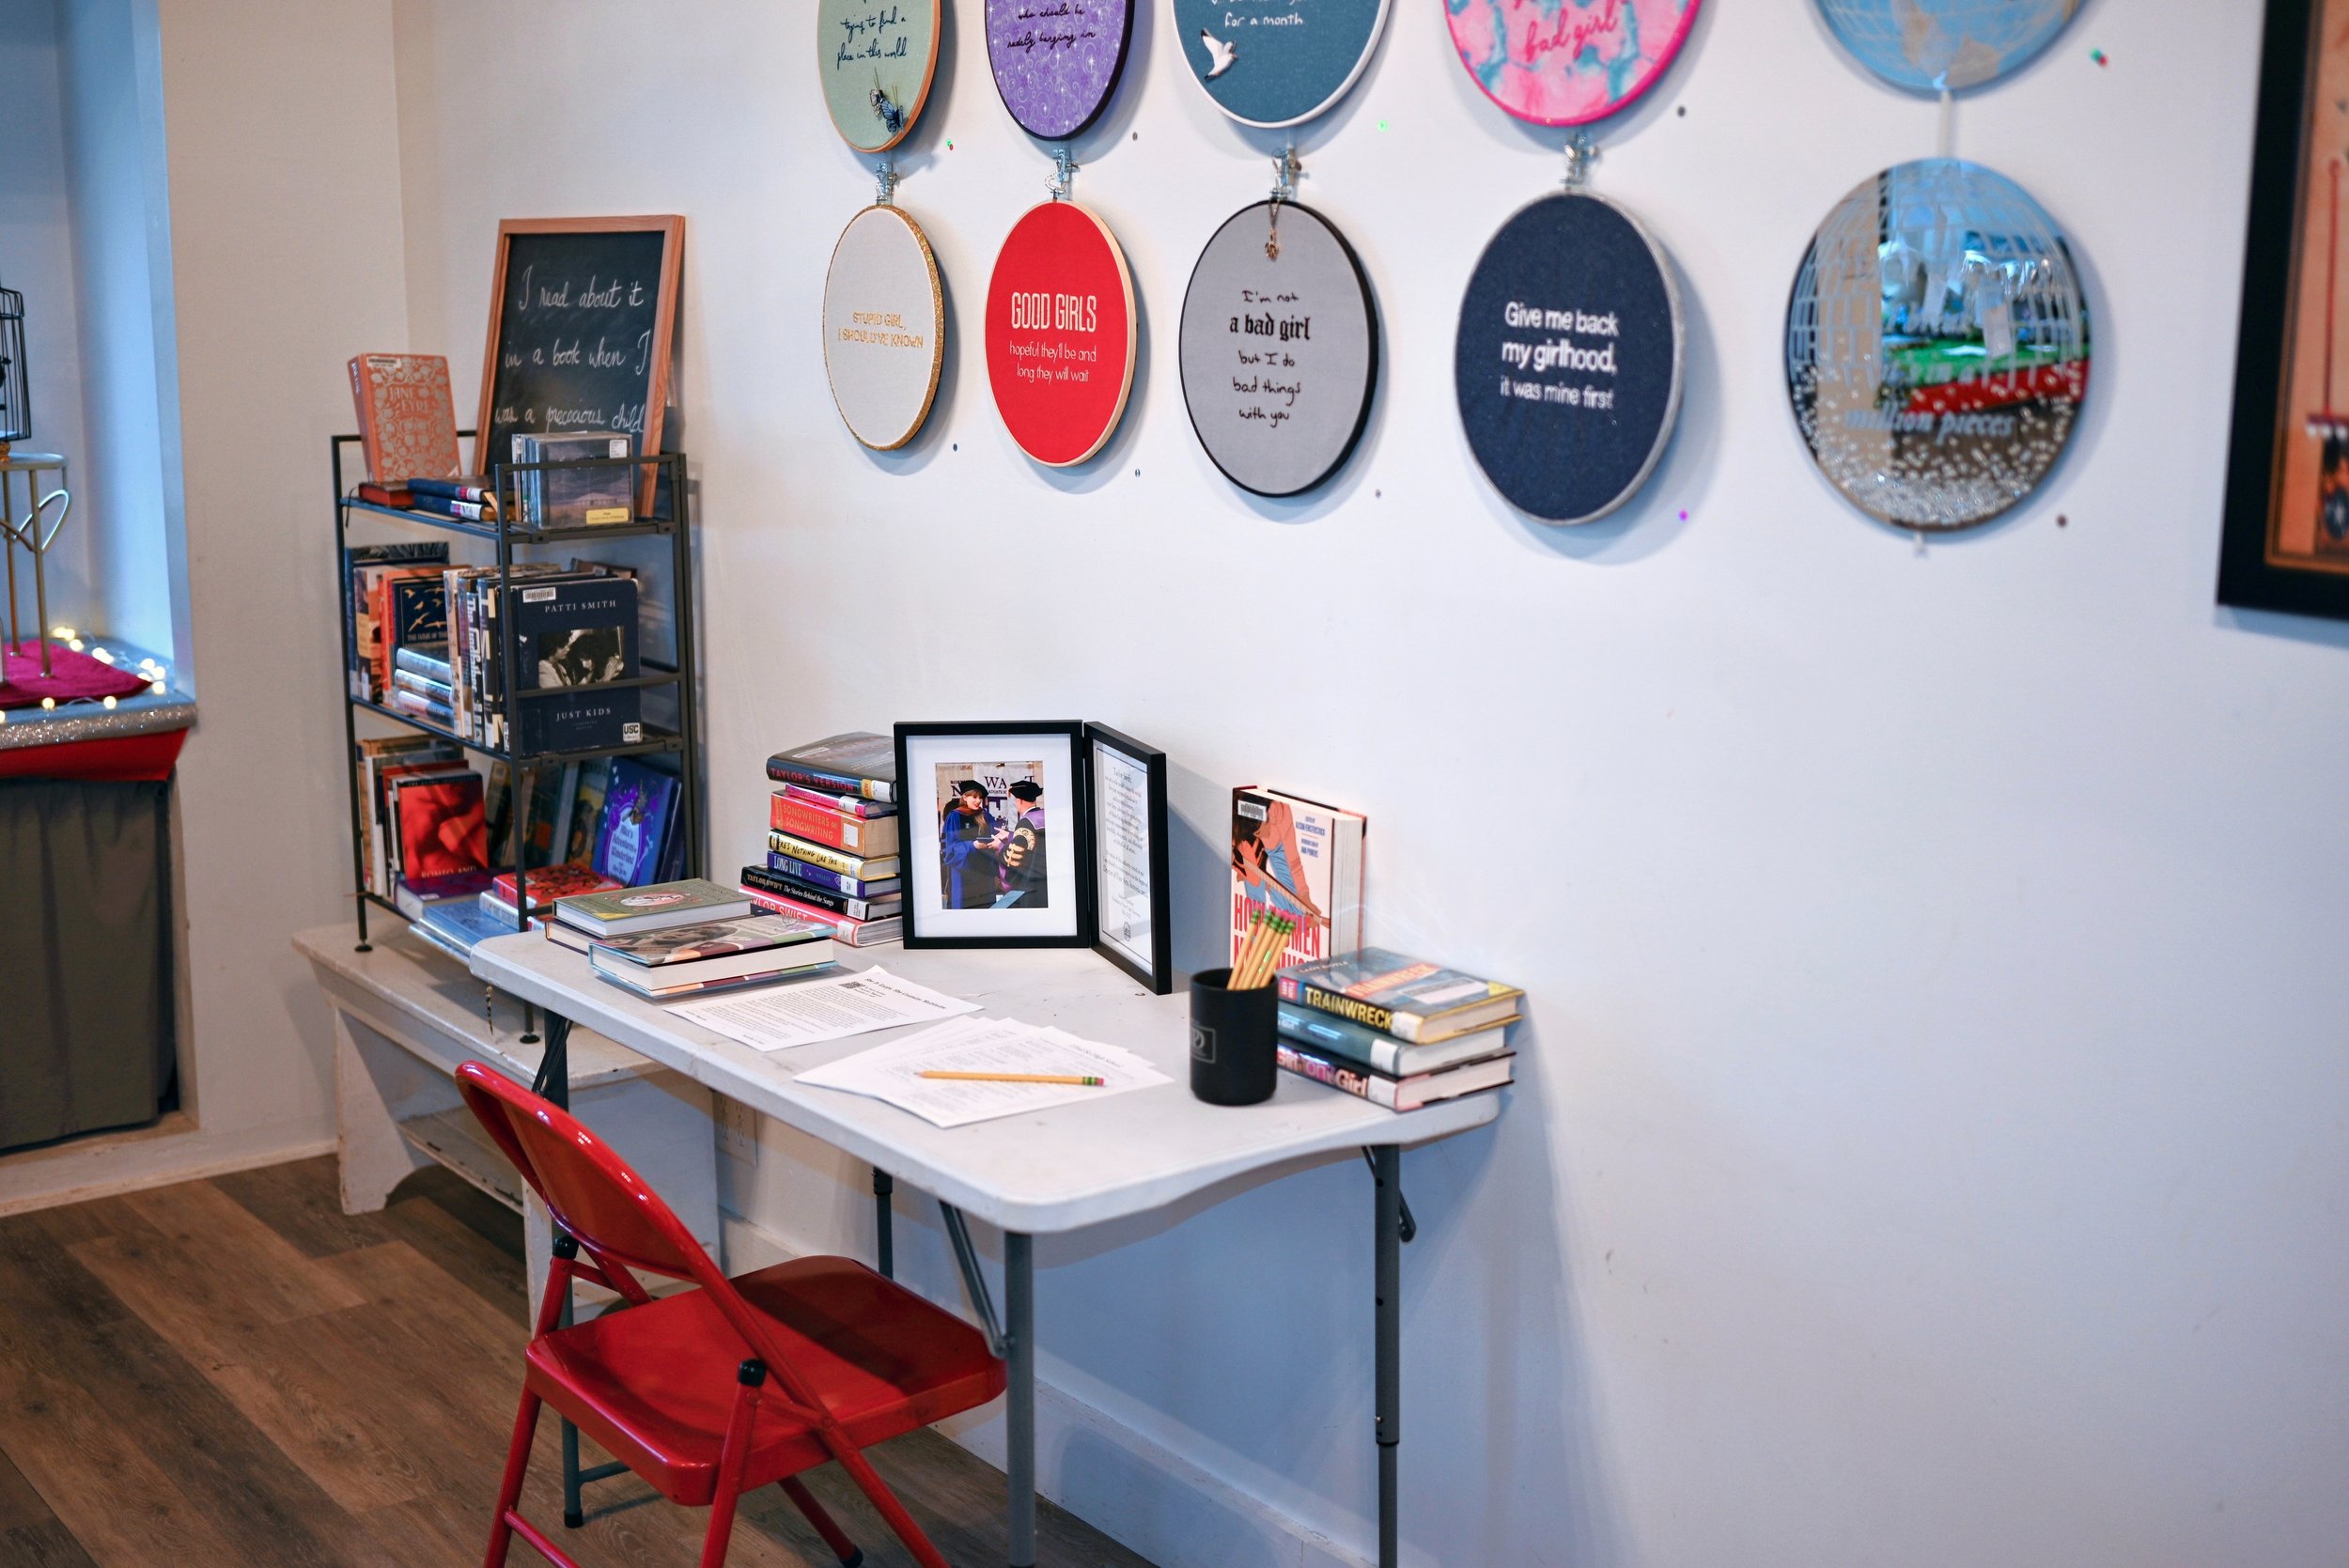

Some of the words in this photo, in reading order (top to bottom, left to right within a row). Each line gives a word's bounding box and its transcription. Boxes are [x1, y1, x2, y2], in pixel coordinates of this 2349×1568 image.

[1074, 4, 1084, 15] be
[1224, 12, 1245, 28] for
[1250, 18, 1258, 26] a
[1263, 12, 1303, 26] month
[840, 15, 865, 43] trying
[865, 15, 876, 27] to
[879, 6, 896, 34] find
[1573, 0, 1618, 59] girl
[837, 42, 854, 70] place
[857, 44, 865, 58] in
[865, 38, 881, 58] this
[884, 37, 907, 58] world
[519, 265, 533, 310] I
[538, 281, 569, 308] read
[579, 274, 622, 308] about
[629, 280, 644, 306] it
[1241, 289, 1271, 303] I'm
[1276, 292, 1299, 302] not
[1011, 291, 1050, 330] GOOD
[1055, 293, 1097, 333] GIRLS
[1504, 301, 1543, 328] Give
[1545, 309, 1574, 331] me
[1575, 308, 1620, 337] back
[1229, 316, 1238, 334] a
[1244, 312, 1274, 336] bad
[1279, 315, 1311, 342] girl
[505, 341, 523, 368] in
[532, 348, 545, 365] a
[552, 338, 580, 366] book
[589, 336, 626, 368] when
[635, 329, 651, 376] I
[890, 333, 924, 348] KNOWN
[1009, 340, 1040, 361] hopeful
[1064, 343, 1077, 359] be
[1078, 345, 1097, 362] and
[1238, 349, 1261, 365] but
[1265, 352, 1278, 365] I
[1283, 353, 1296, 367] do
[1501, 341, 1532, 369] my
[1017, 363, 1035, 383] long
[1036, 365, 1053, 385] they
[1055, 365, 1069, 380] will
[1070, 369, 1090, 382] wait
[1233, 376, 1258, 393] bad
[1263, 379, 1300, 407] things
[1501, 375, 1510, 396] it
[1513, 380, 1542, 400] was
[1544, 381, 1580, 406] mine
[1582, 384, 1614, 410] first
[495, 406, 518, 424] was
[524, 408, 536, 424] a
[612, 403, 645, 433] child
[1238, 407, 1266, 419] with
[1270, 411, 1289, 428] you
[545, 603, 578, 613] PATTI
[581, 599, 616, 610] SMITH
[556, 710, 581, 722] JUST
[586, 707, 611, 717] KIDS
[623, 724, 639, 735] USC
[770, 768, 811, 784] TAYLOR'S
[813, 776, 854, 792] VERSION
[783, 803, 830, 827] SONGWRITERS
[785, 818, 833, 841] SONGWRITING
[773, 855, 788, 872] LONG
[789, 861, 803, 876] LIVE
[791, 846, 816, 857] NOTHING
[816, 854, 827, 863] LIKE
[747, 874, 766, 884] TAYLOR
[766, 881, 783, 890] SWIFT
[790, 888, 803, 896] Stories
[803, 891, 817, 901] Behind
[823, 899, 834, 908] Songs
[1305, 986, 1392, 1030] TRAINWRECK
[1334, 1068, 1369, 1096] Girl
